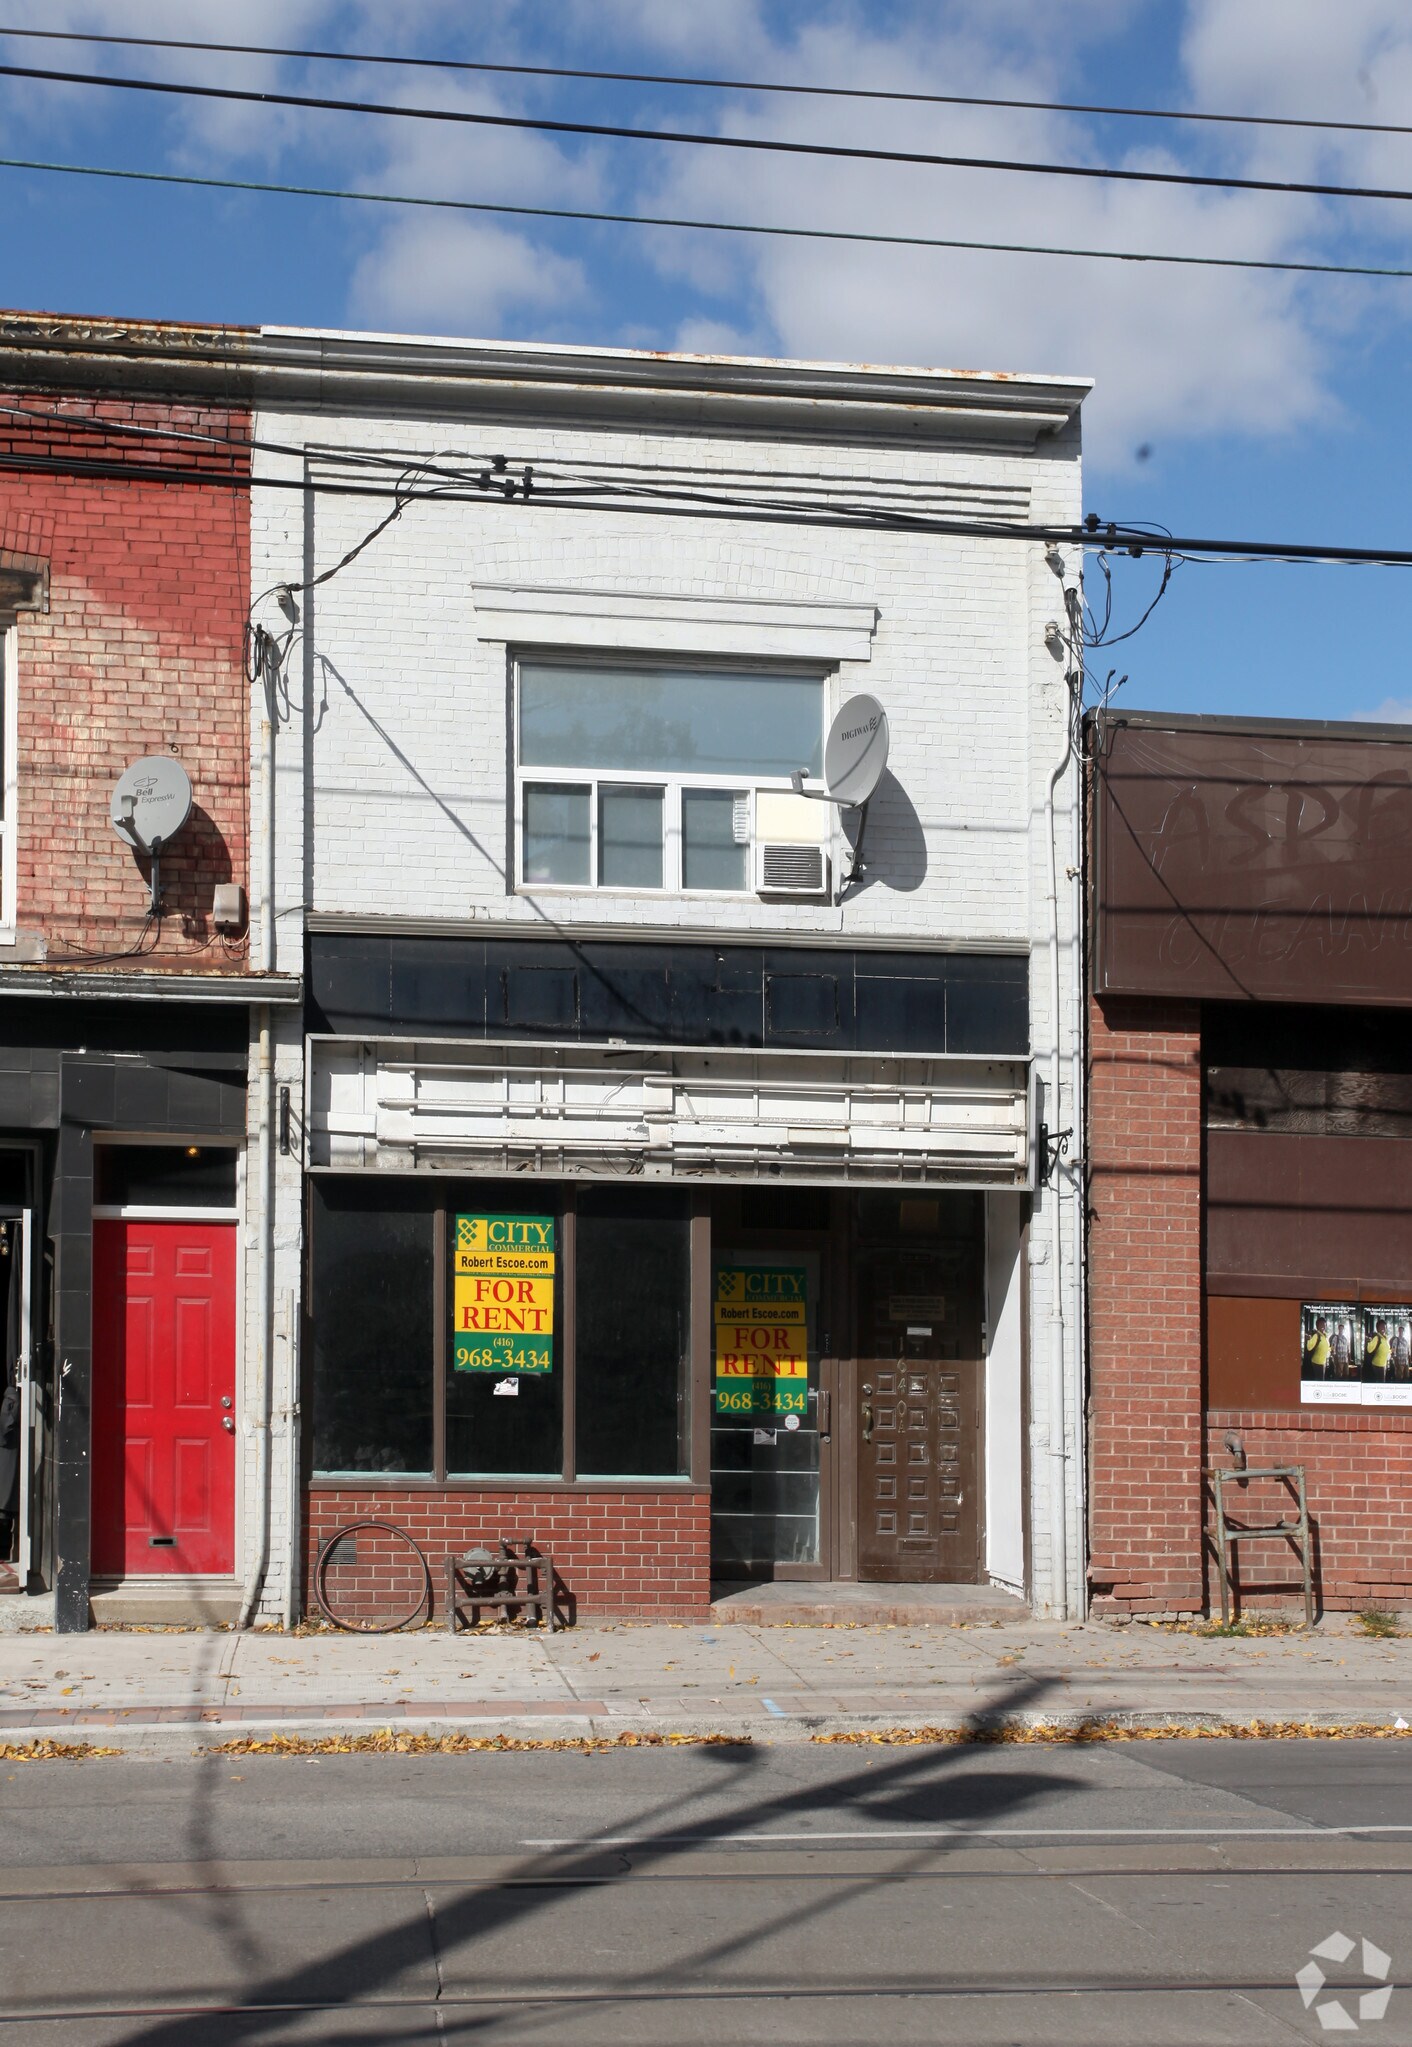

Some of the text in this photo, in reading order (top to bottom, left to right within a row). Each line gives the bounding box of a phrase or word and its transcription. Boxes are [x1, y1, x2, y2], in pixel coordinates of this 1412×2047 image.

[136, 787, 154, 797] Bell
[488, 1221, 552, 1244] CITY
[461, 1256, 549, 1269] Robert Escoe.com
[474, 1279, 536, 1304] FOR
[746, 1273, 804, 1294] CITY
[461, 1306, 548, 1331] RENT
[720, 1307, 799, 1320] Robert Escoe.com
[493, 1337, 514, 1349] (416)
[734, 1327, 791, 1350] FOR
[456, 1347, 550, 1369] 968-3434
[722, 1353, 801, 1376] RENT
[752, 1381, 771, 1392] (416)
[719, 1391, 805, 1411] 968-3434
